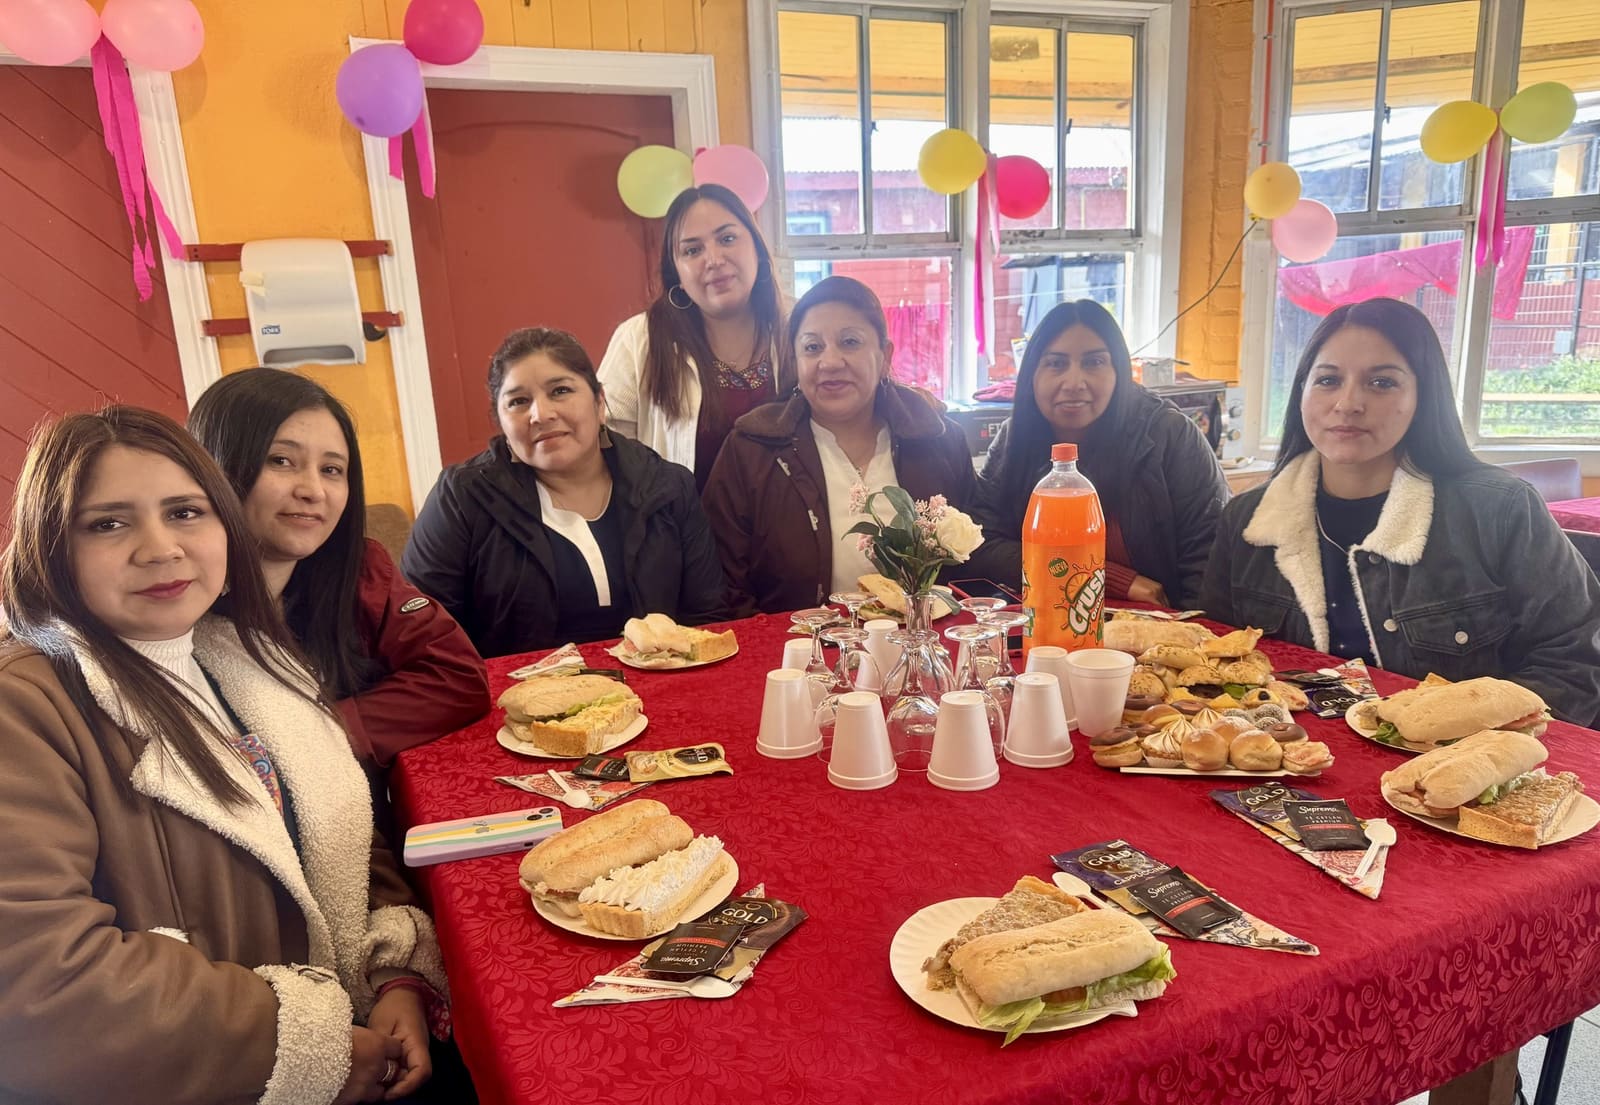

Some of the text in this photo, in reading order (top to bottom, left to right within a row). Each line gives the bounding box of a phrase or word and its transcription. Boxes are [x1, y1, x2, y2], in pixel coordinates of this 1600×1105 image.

[1049, 560, 1068, 575] NUEVA
[1069, 569, 1105, 633] Crush
[1321, 697, 1359, 707] GOLD
[1246, 788, 1285, 805] GOLD
[1088, 850, 1132, 866] GOLD
[1113, 864, 1170, 885] CAPPUCCINO
[721, 907, 769, 924] GOLD
